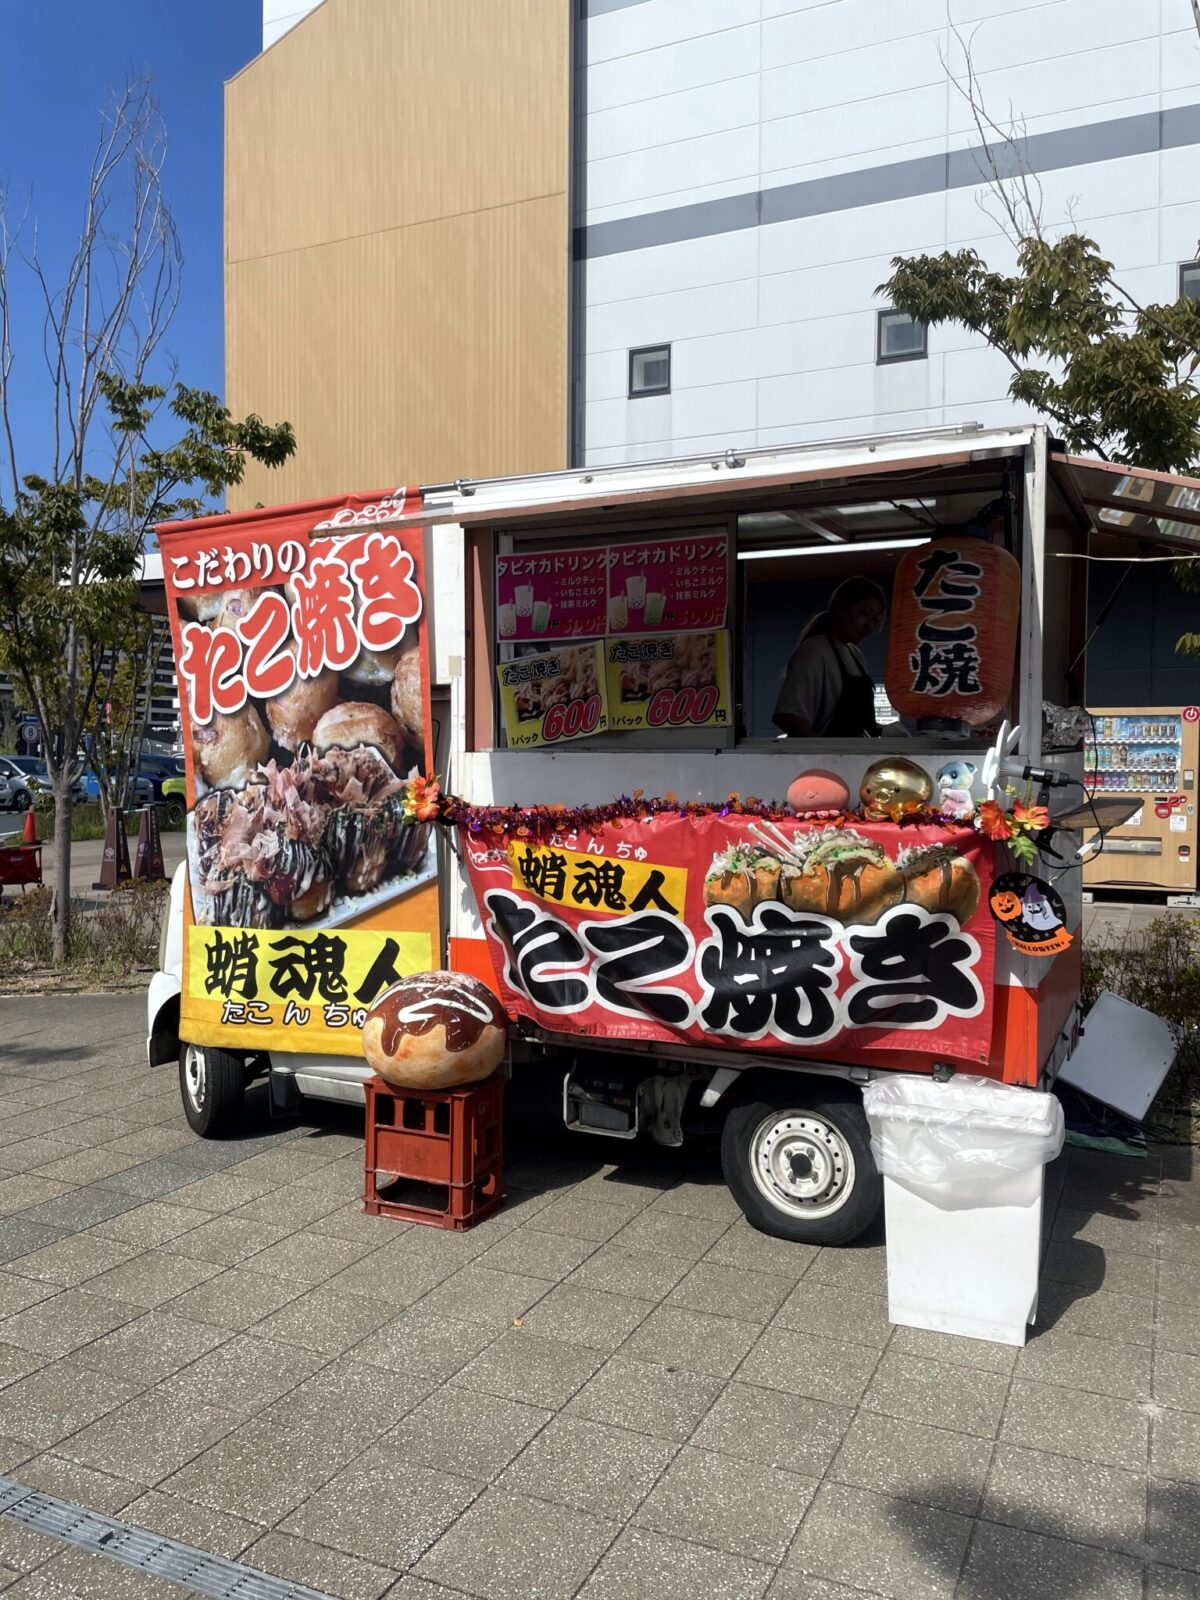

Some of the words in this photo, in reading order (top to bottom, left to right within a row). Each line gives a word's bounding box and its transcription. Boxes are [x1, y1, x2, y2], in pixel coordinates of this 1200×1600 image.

[170, 540, 306, 589] こだわりの
[180, 532, 423, 725] たこ焼き
[610, 640, 674, 662] たこ焼き
[909, 548, 983, 697] たこ焼
[502, 658, 561, 686] たこ焼き
[518, 847, 680, 917] 蛸魂人
[484, 889, 985, 1045] たこ焼き
[1014, 940, 1062, 952] HALLOWEEN
